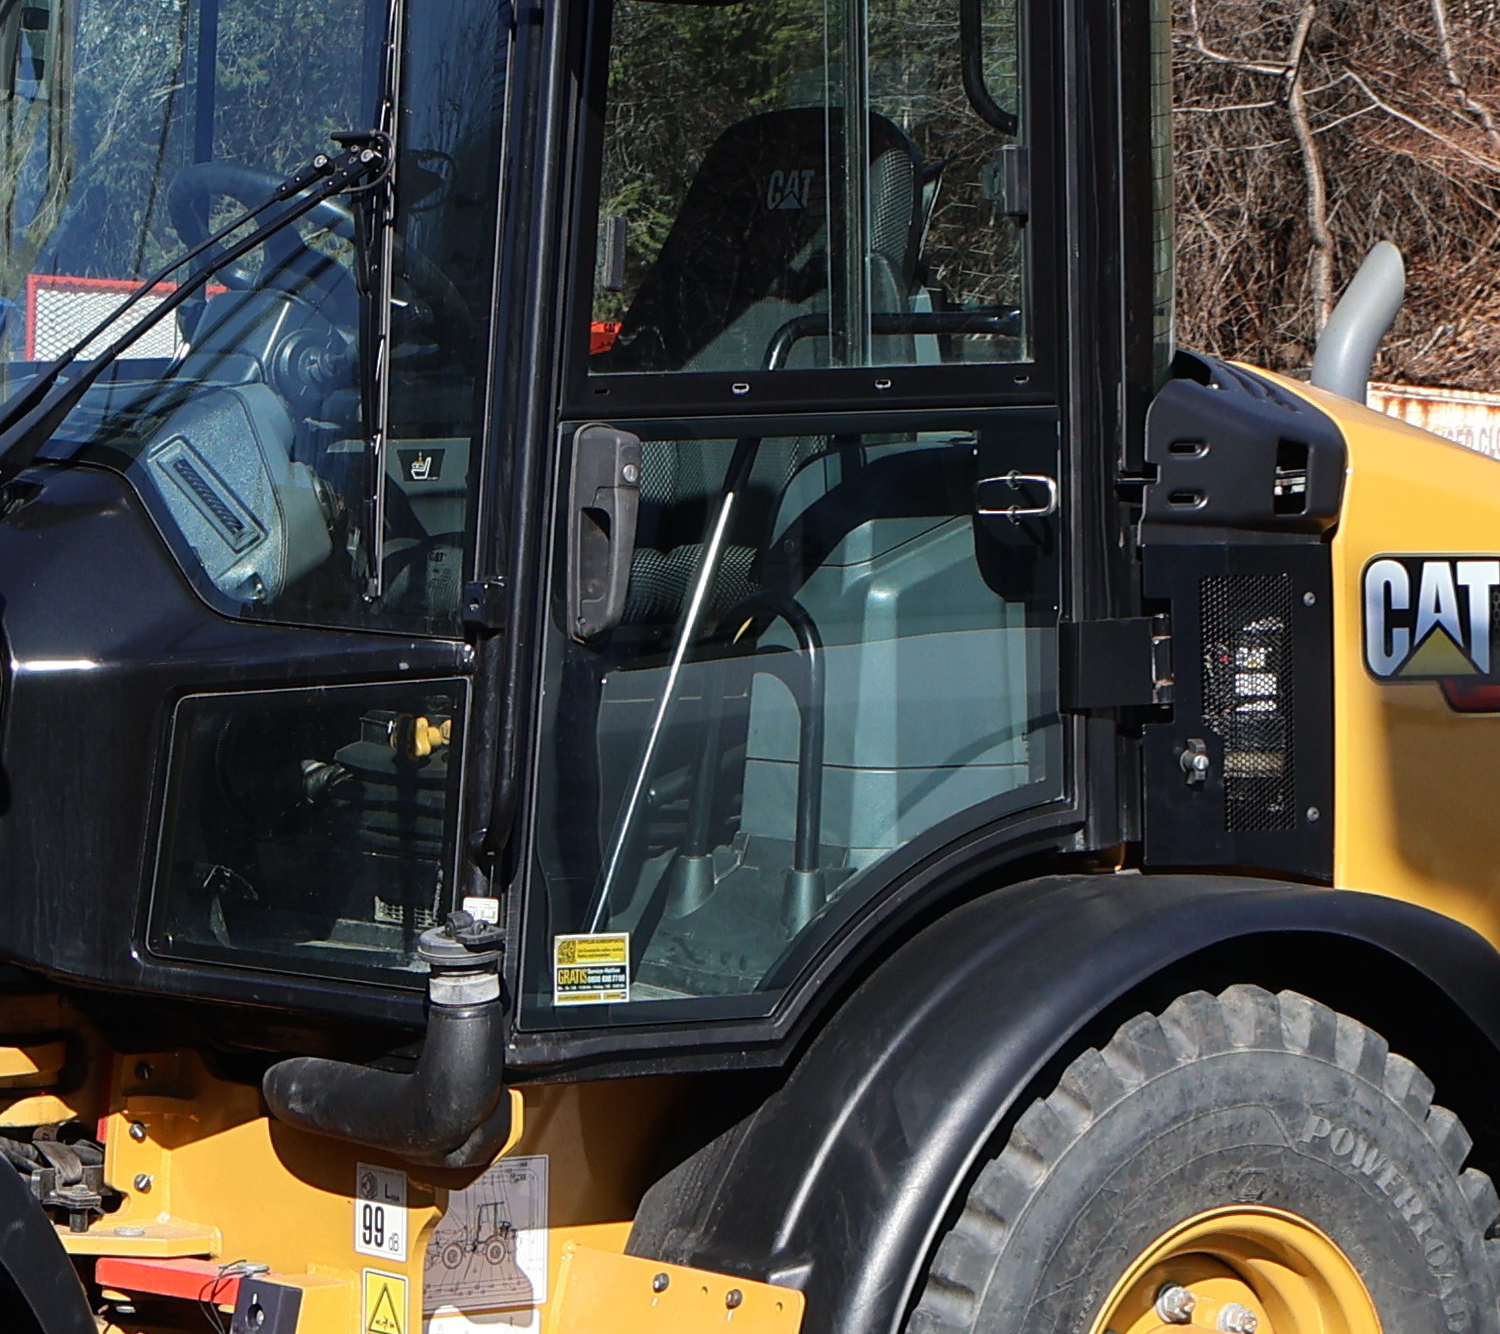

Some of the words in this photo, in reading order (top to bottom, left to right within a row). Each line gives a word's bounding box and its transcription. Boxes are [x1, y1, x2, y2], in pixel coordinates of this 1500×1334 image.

[766, 169, 816, 210] CAT
[1441, 428, 1474, 449] SED
[1364, 559, 1500, 677] CAT
[558, 969, 587, 984] GRATIS
[362, 1203, 385, 1248] 99
[388, 1233, 400, 1253] dB
